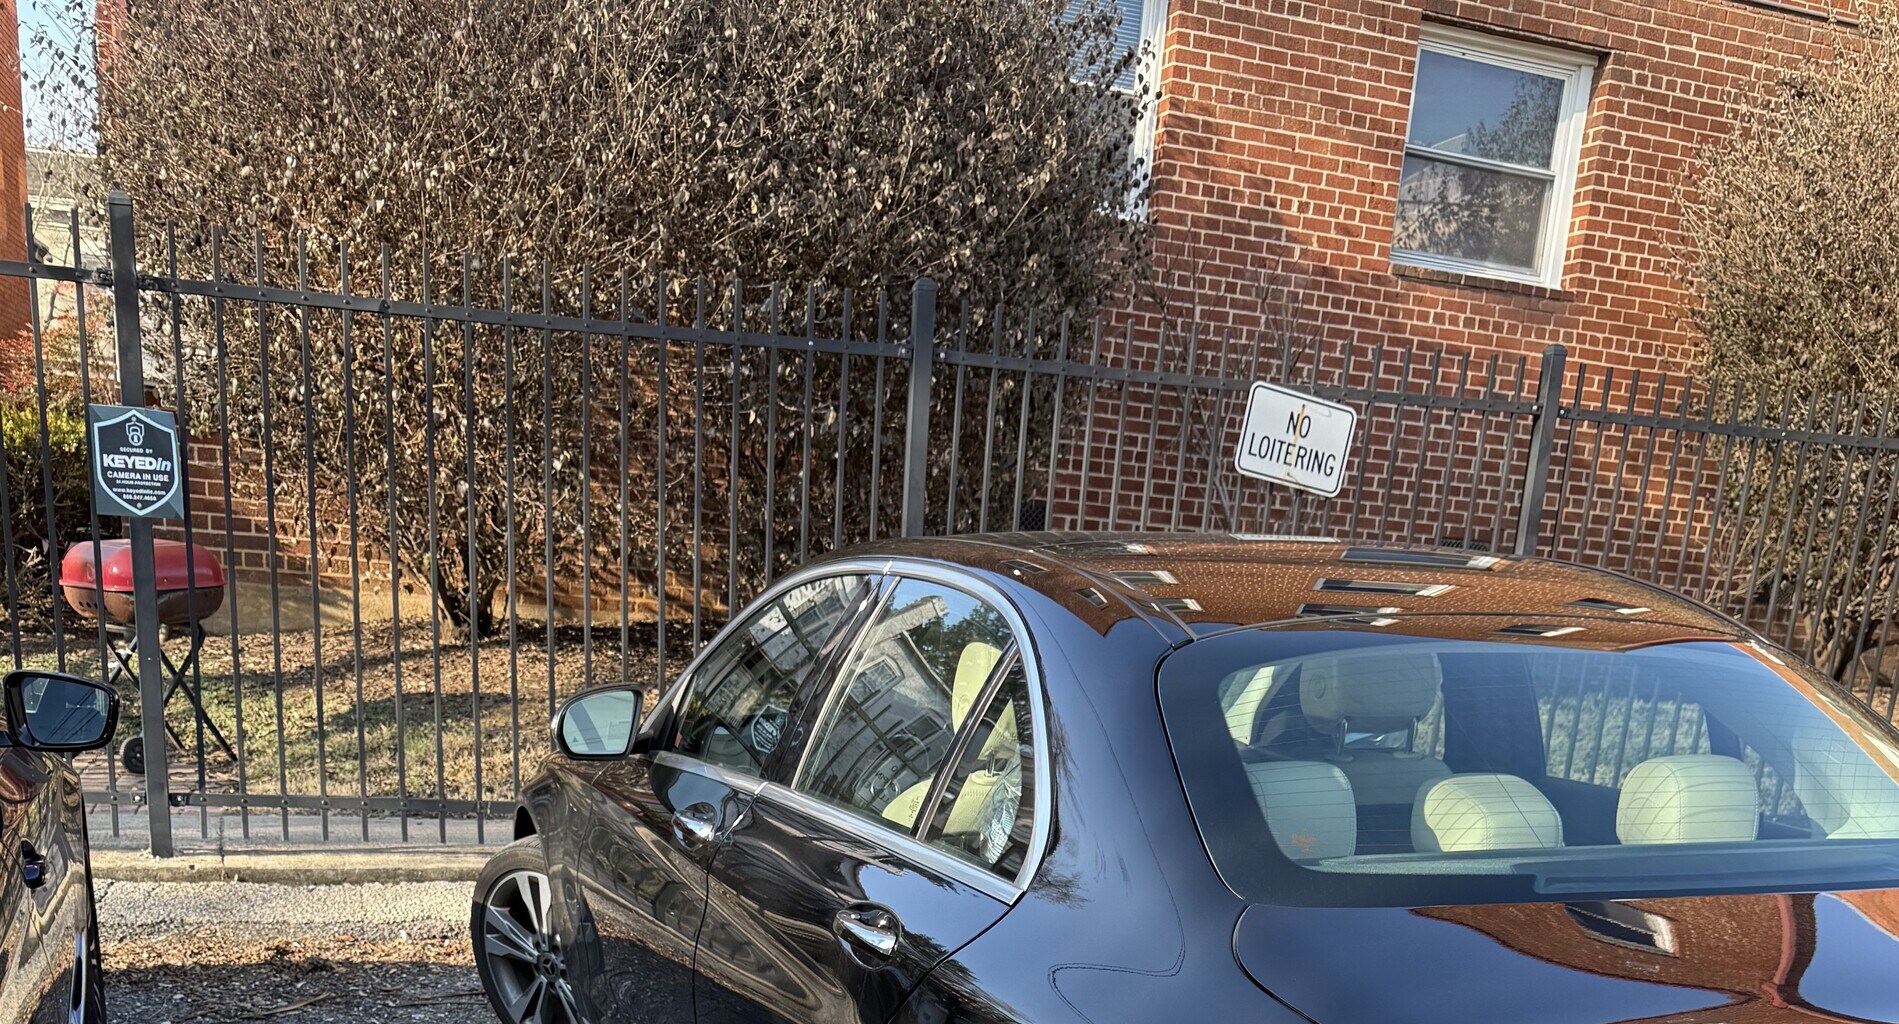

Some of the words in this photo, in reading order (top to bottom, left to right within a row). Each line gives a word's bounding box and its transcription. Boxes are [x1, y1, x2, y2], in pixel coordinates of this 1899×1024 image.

[1286, 411, 1311, 438] NO
[119, 446, 144, 454] SECURED
[1248, 432, 1336, 477] LOITERING
[102, 453, 171, 471] KEYEDin
[107, 471, 141, 480] CAMERA
[142, 473, 151, 481] IN
[153, 474, 169, 482] USE
